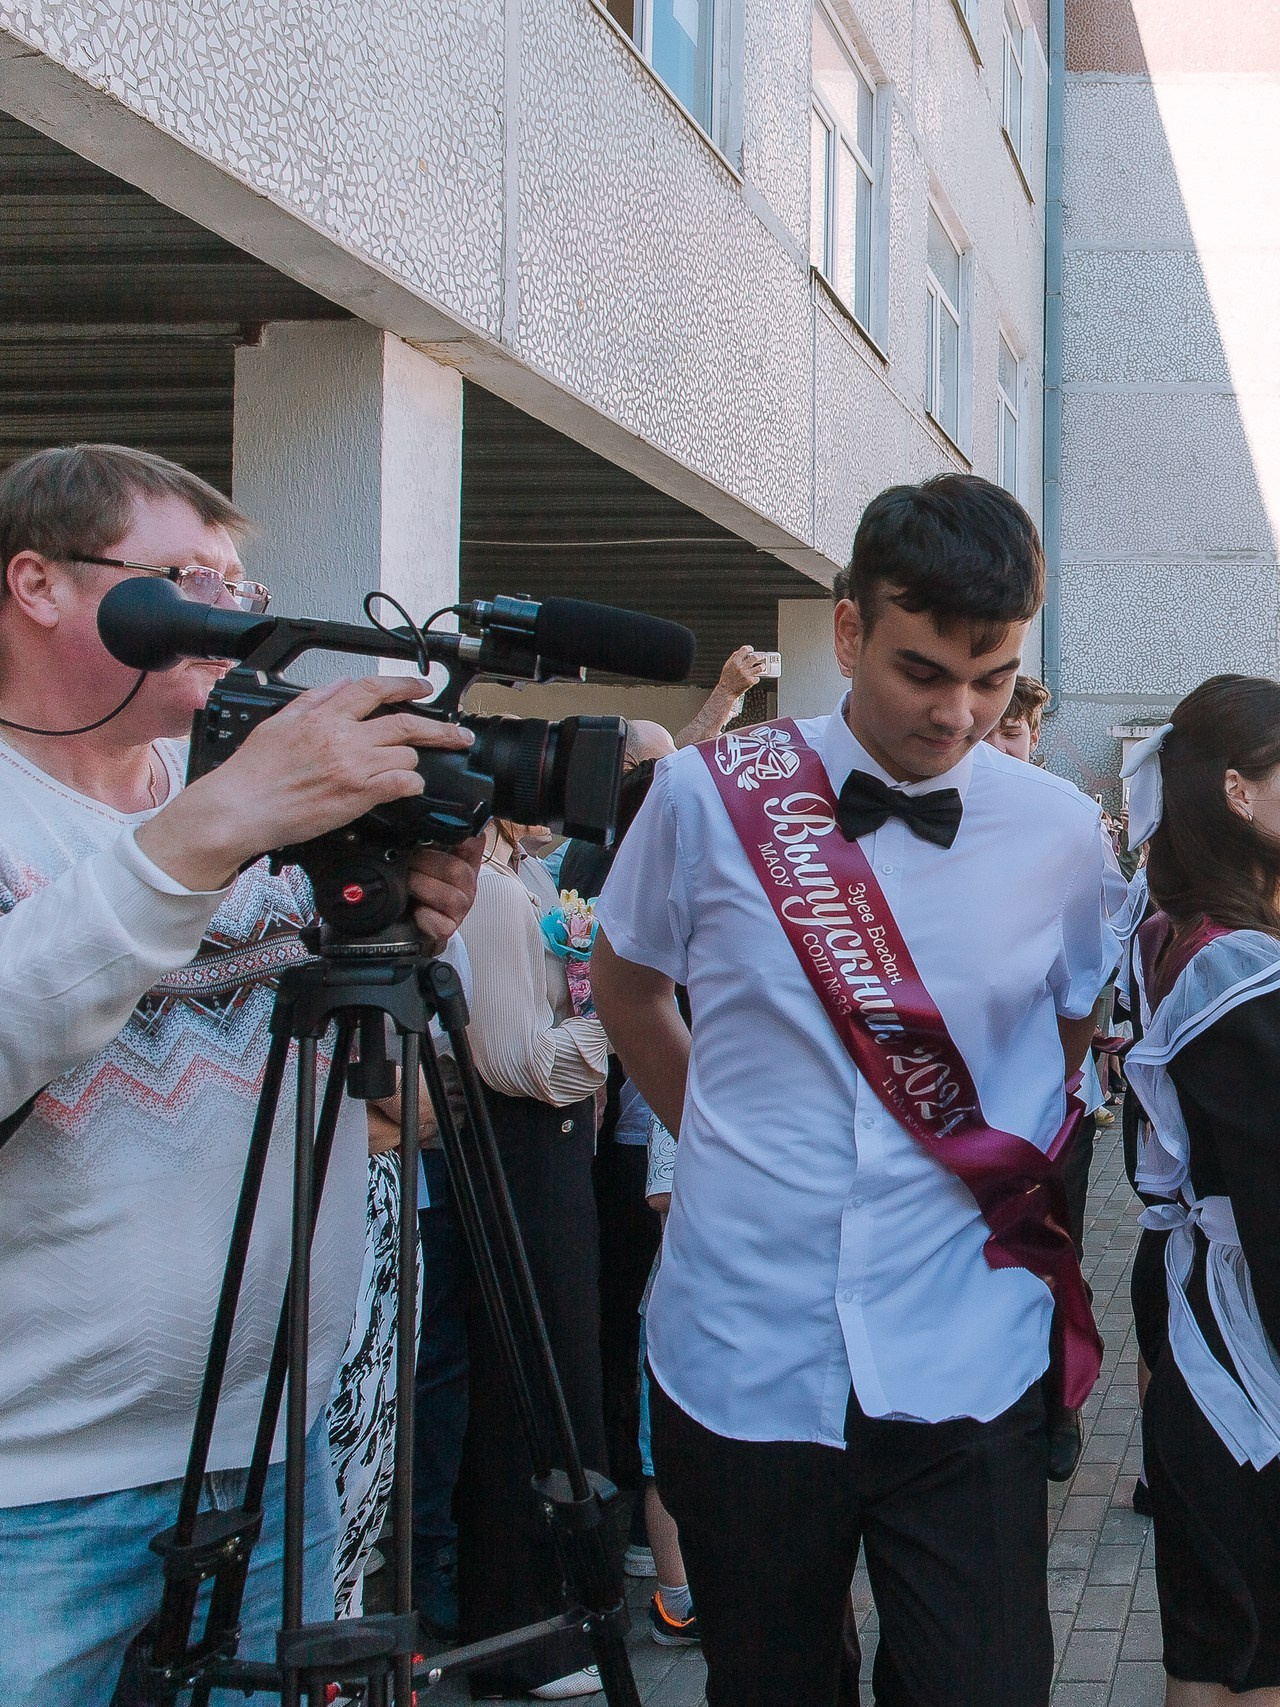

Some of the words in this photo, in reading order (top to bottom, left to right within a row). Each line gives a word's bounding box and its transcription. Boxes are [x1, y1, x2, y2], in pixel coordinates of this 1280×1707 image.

[757, 841, 793, 888] МАОУ
[802, 933, 832, 977] СОШ
[763, 792, 906, 1045] Выпускник
[886, 1046, 976, 1139] 2024
[847, 882, 875, 924] Зуев
[867, 926, 904, 984] Богдан
